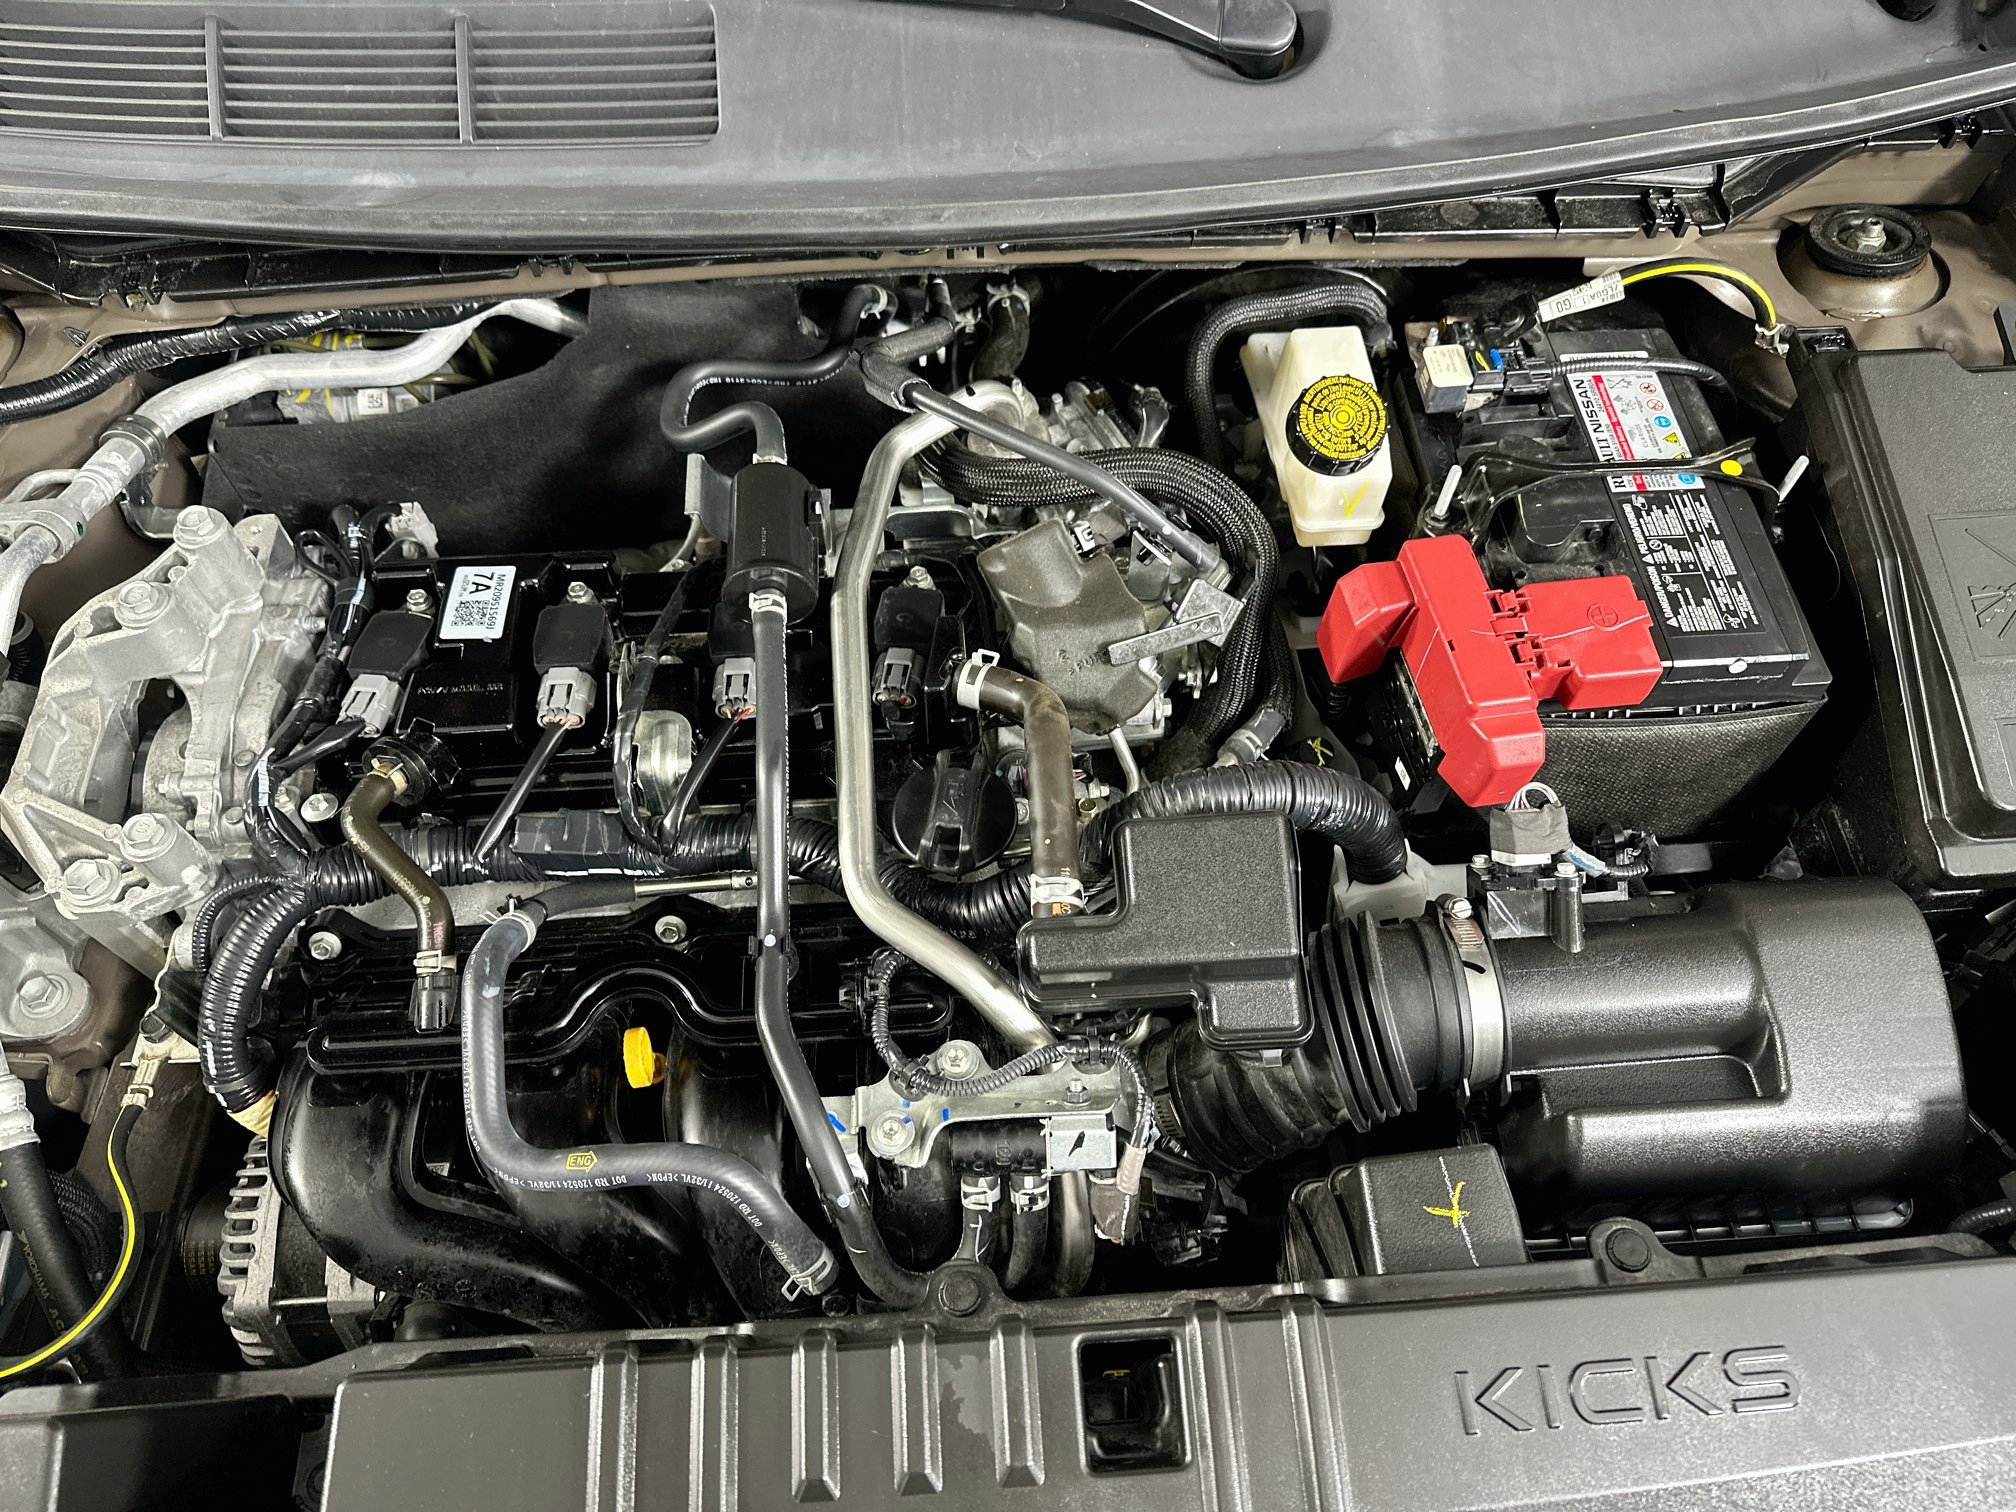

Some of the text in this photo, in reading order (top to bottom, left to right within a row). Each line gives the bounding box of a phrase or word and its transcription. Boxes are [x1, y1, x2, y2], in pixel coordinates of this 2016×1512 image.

[1573, 379, 1605, 433] NISSAN
[1622, 503, 1649, 555] PELIGRO/VENENO
[469, 571, 495, 595] 7A
[1646, 566, 1674, 618] DANGER/POISON
[570, 1155, 592, 1167] ENG
[527, 1180, 561, 1189] 11/32VL
[562, 1178, 593, 1189] 120524
[611, 1174, 628, 1185] DOT
[680, 1173, 713, 1189] 11/32VL
[713, 1183, 742, 1205] 120524
[748, 1213, 763, 1227] DOT
[23, 1244, 50, 1300] YOKOHAMA
[1453, 1344, 1803, 1437] KICKS
